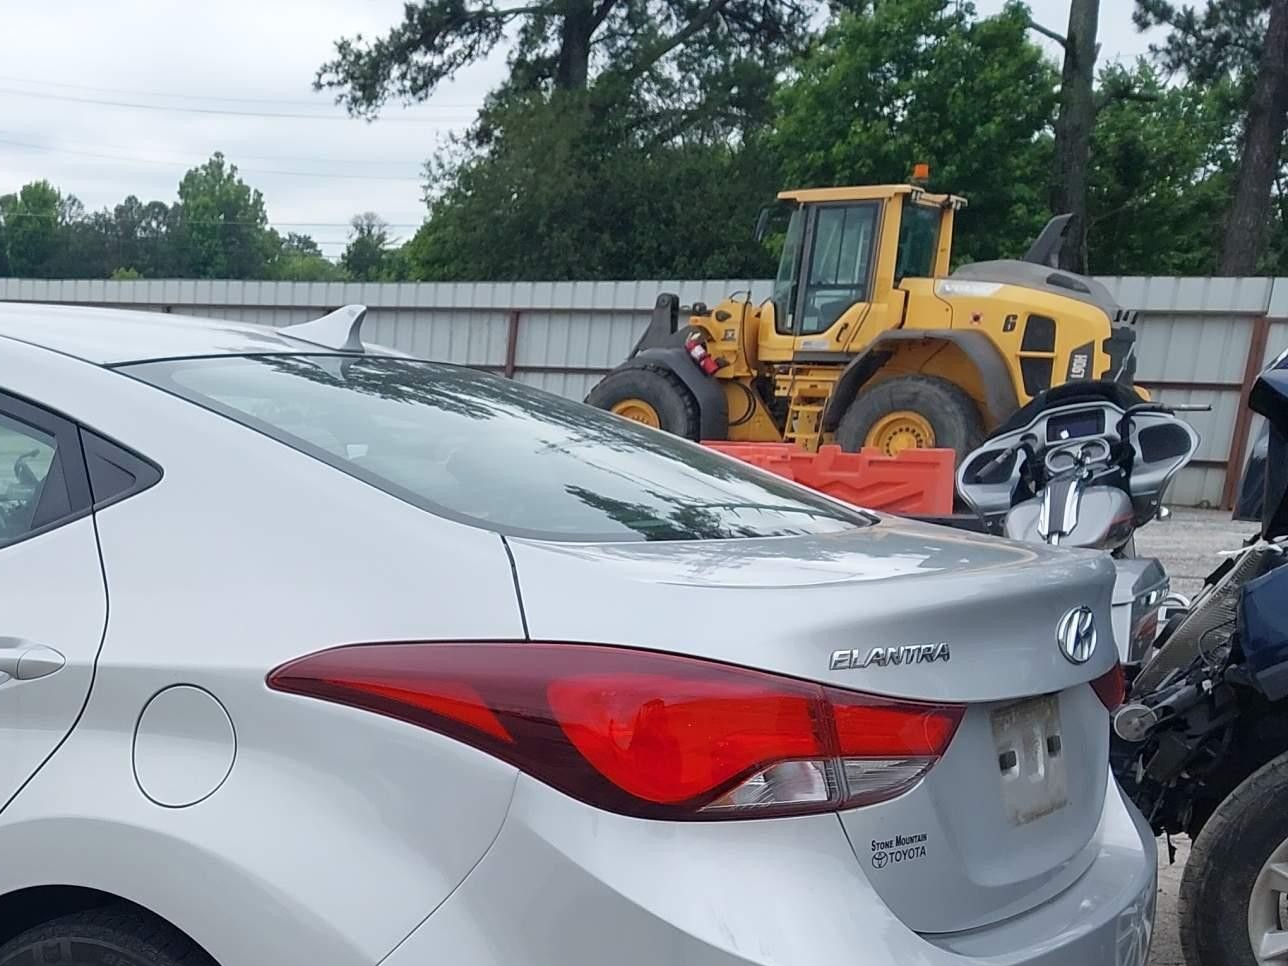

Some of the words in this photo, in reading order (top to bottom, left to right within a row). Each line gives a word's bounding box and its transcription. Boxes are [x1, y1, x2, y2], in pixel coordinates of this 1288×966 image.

[1070, 354, 1088, 379] L90H
[829, 642, 951, 670] ELANTRA
[889, 845, 927, 863] TOYOTA
